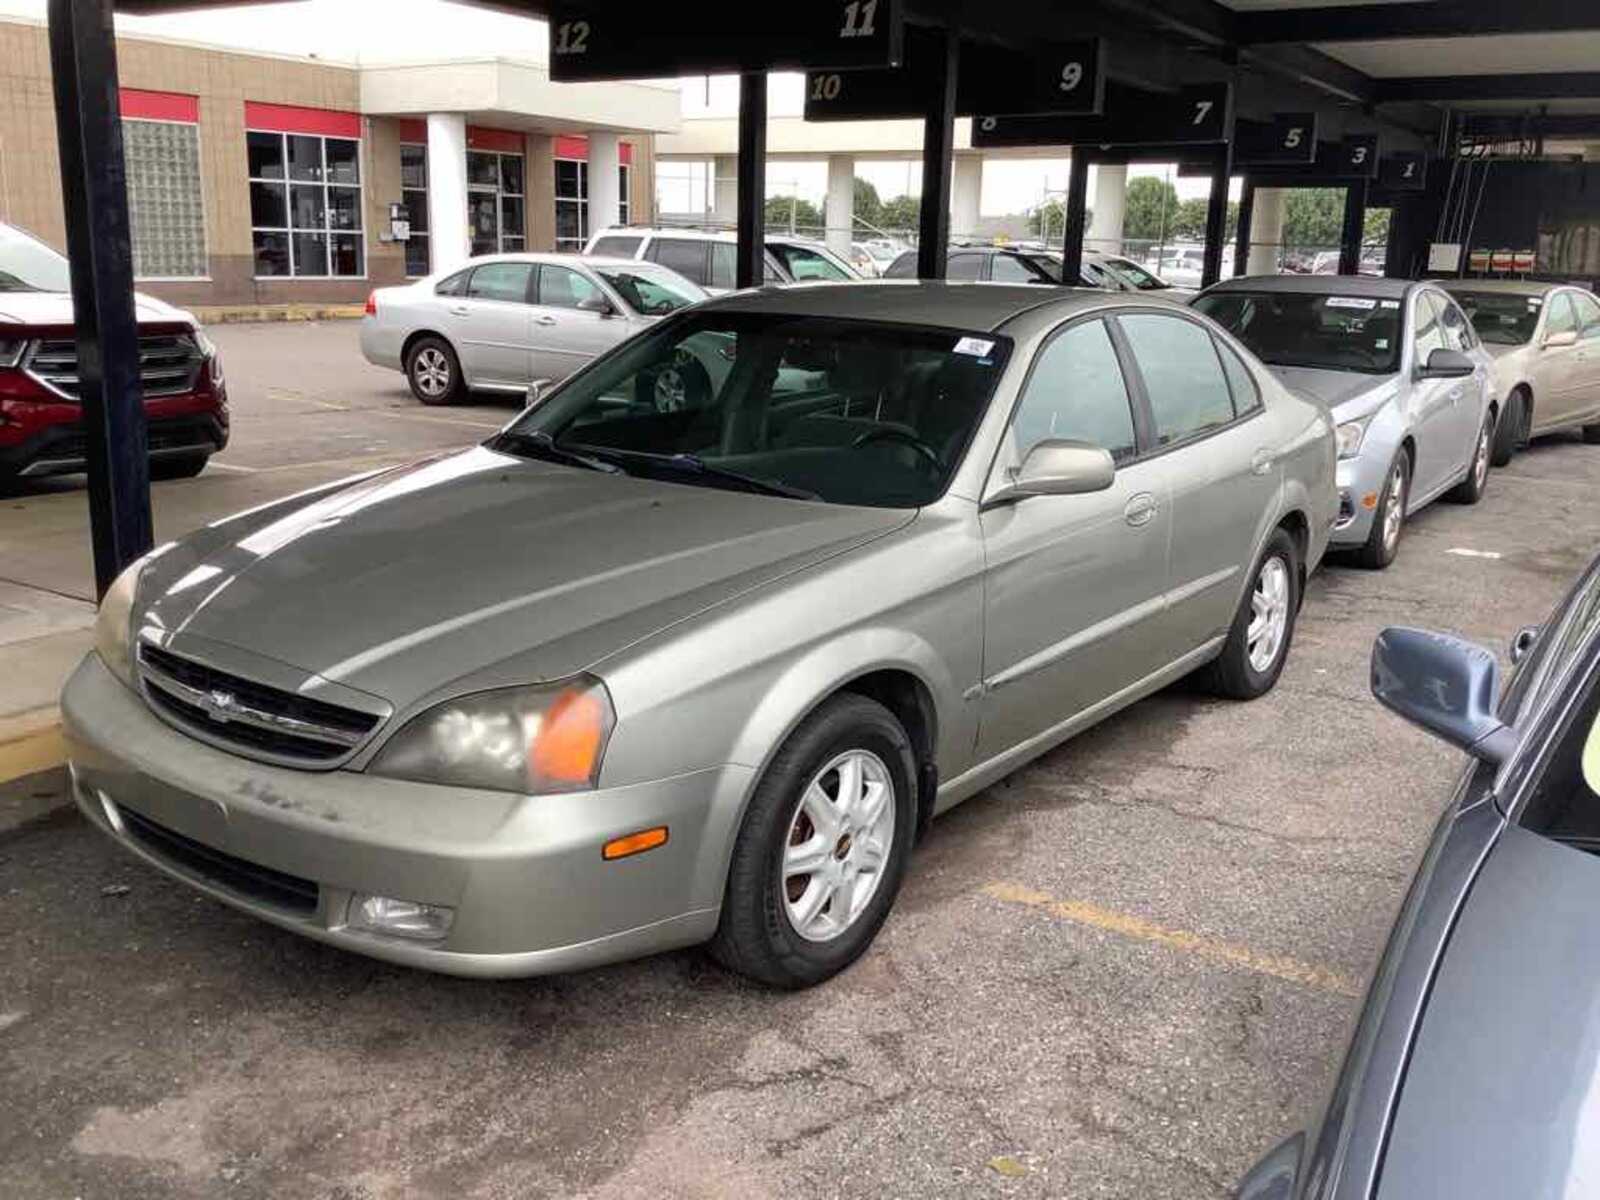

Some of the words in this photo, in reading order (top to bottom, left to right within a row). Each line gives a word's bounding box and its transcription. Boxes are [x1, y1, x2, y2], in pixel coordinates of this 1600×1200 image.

[840, 0, 878, 38] 11
[556, 22, 590, 54] 12
[811, 74, 841, 100] 10
[1060, 62, 1083, 91] 9
[1193, 101, 1213, 125] 7
[1284, 128, 1303, 148] 5
[1351, 146, 1368, 164] 3
[1401, 161, 1416, 179] 1
